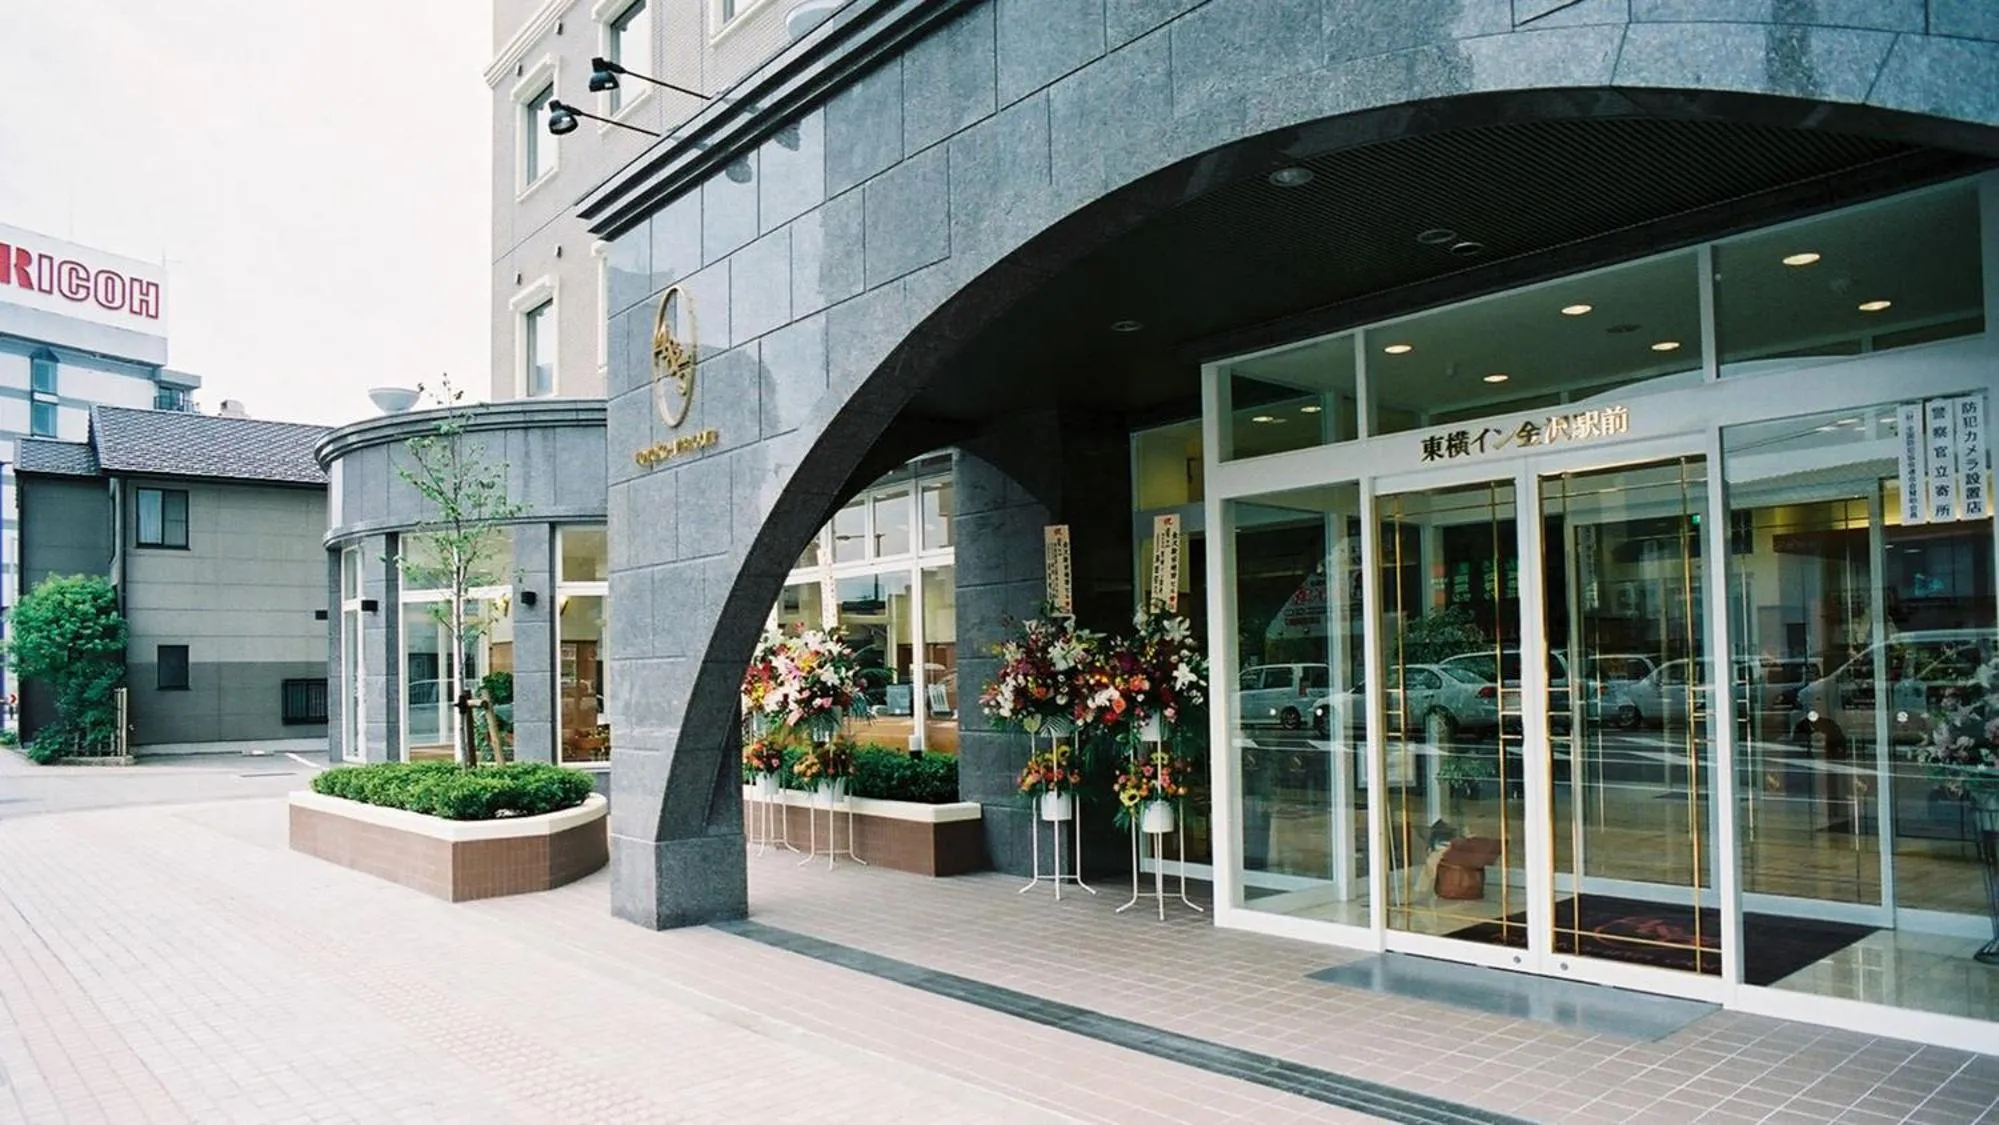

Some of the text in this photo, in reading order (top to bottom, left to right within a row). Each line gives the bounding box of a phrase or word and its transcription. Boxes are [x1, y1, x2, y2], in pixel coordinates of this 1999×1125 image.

[0, 241, 159, 320] RICOH
[1420, 405, 1630, 462] 東横イン金沢駅前
[1931, 406, 1950, 517] 警察官立寄所
[1961, 401, 1982, 514] 防犯カメラ設置店
